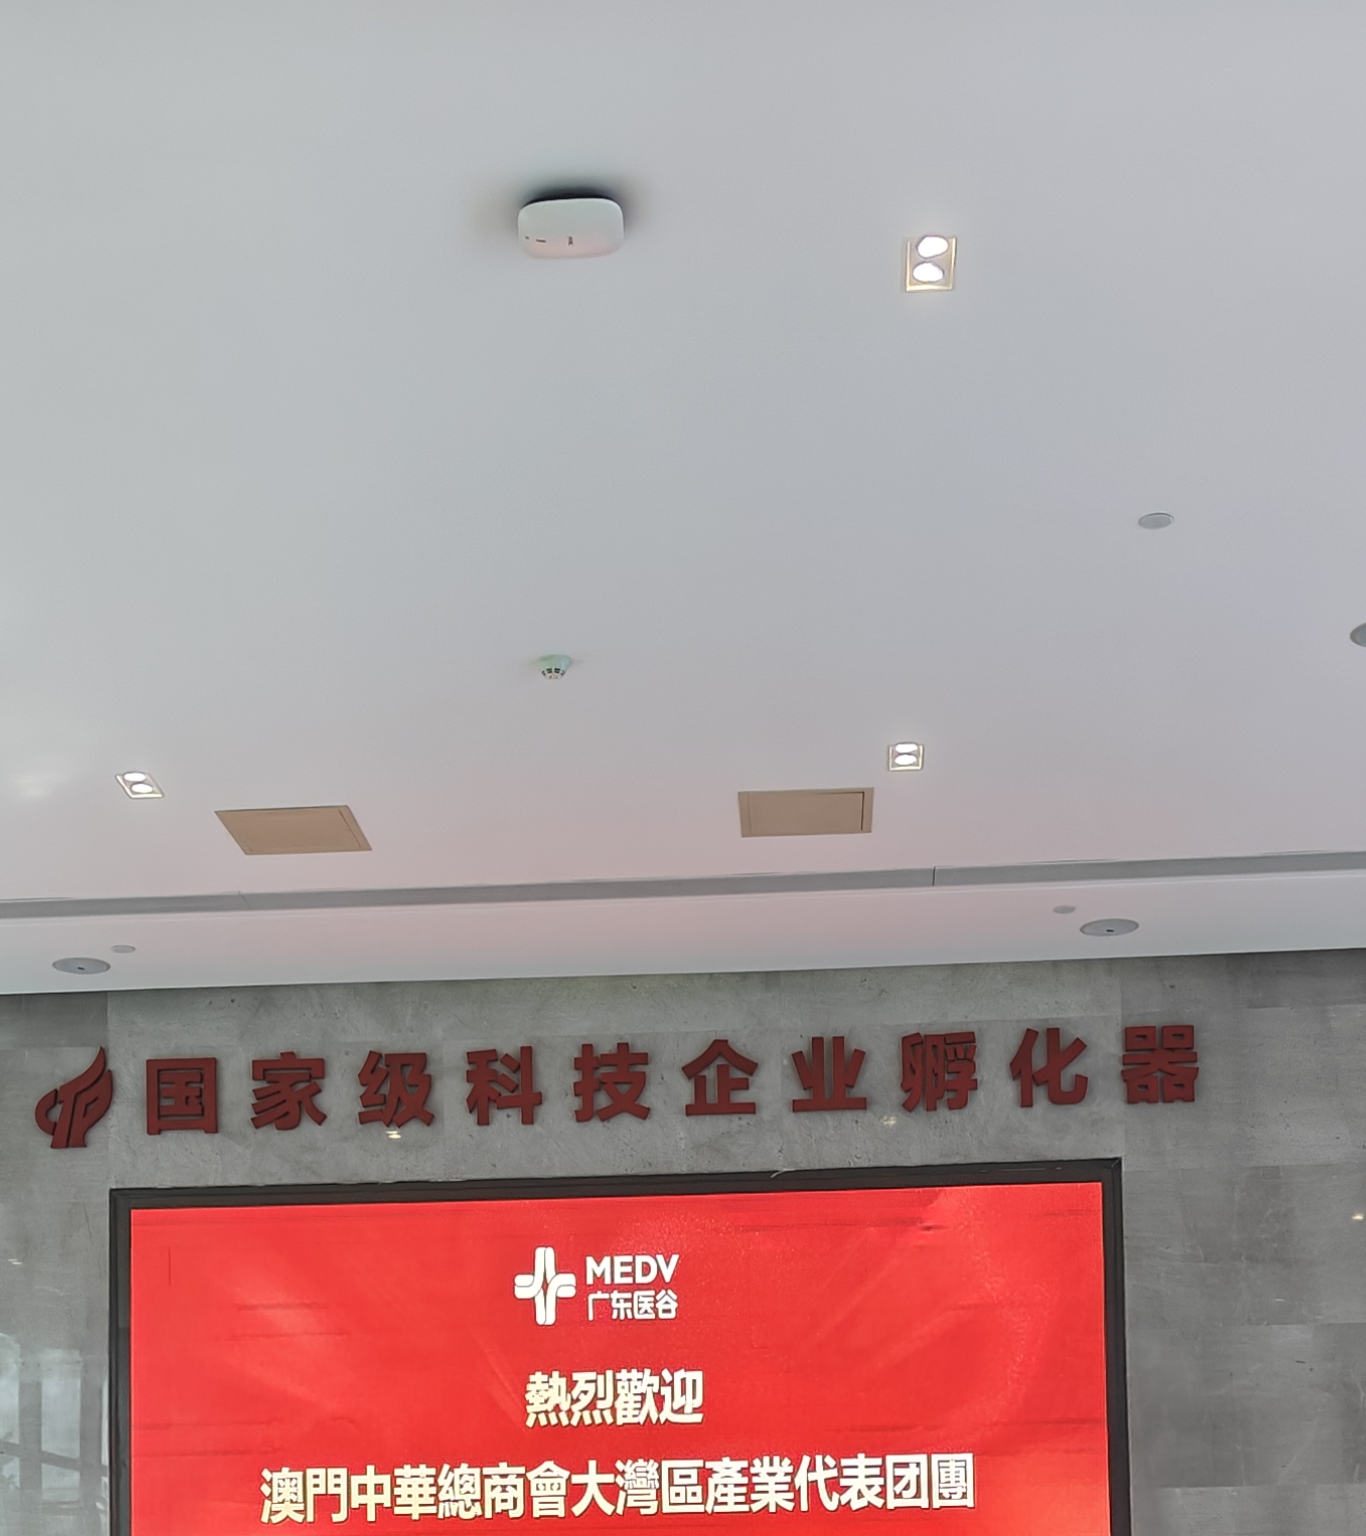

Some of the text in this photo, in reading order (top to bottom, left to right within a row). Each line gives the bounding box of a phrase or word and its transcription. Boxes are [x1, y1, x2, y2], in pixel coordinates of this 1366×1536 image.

[146, 1025, 1200, 1135] 国家级科技企业孵化器
[586, 1254, 679, 1285] MEDV
[588, 1289, 678, 1321] 广东医谷
[524, 1368, 704, 1428] 熱烈歡迎
[260, 1453, 975, 1524] 澳門中華總商會大灣區產業代表团團
